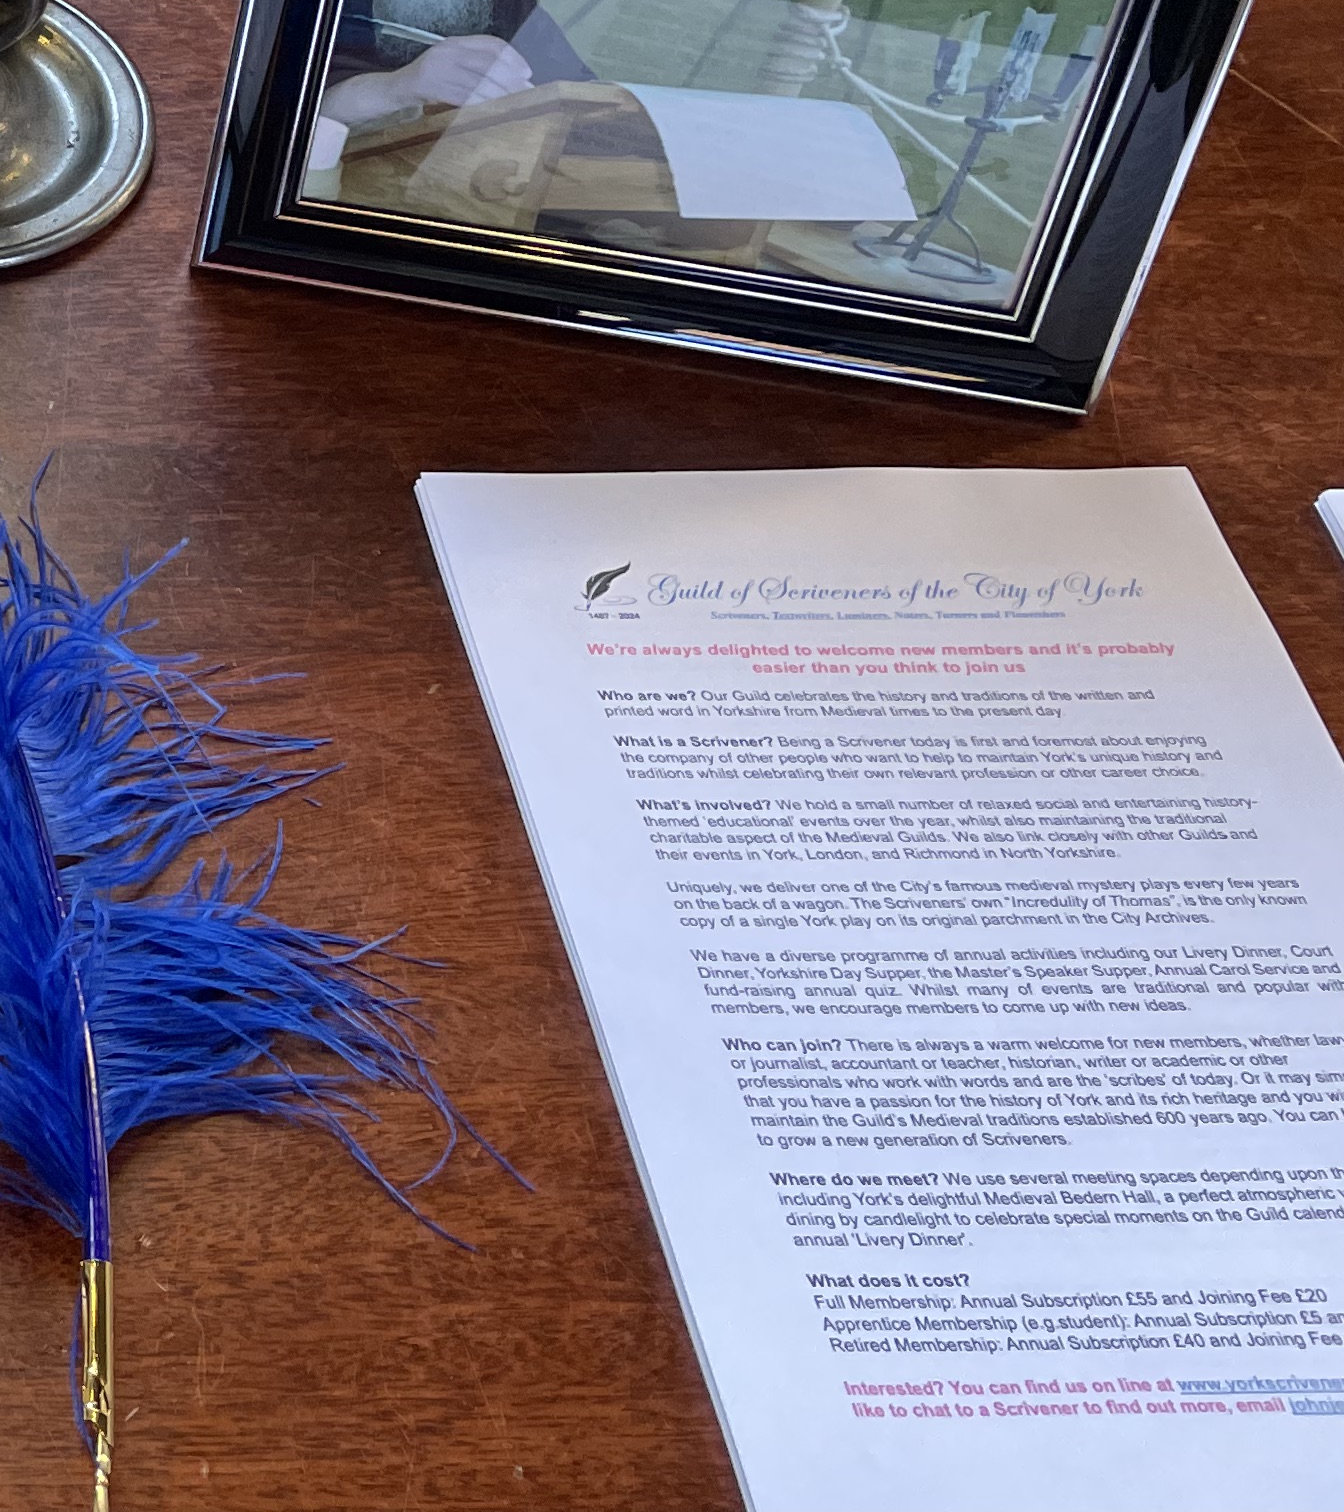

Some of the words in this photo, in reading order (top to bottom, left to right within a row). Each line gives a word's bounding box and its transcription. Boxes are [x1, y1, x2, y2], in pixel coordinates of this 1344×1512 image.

[647, 573, 724, 606] Guild
[730, 579, 755, 606] of
[758, 576, 892, 604] Scriveners
[898, 580, 925, 609] of
[925, 580, 958, 600] the
[964, 572, 1028, 609] City
[1038, 580, 1060, 608] of
[1064, 573, 1144, 608] York
[813, 1294, 846, 1310] Full
[847, 1294, 957, 1313] Membership:
[960, 1293, 1018, 1309] Annual
[1020, 1292, 1124, 1311] Subscription
[1125, 1291, 1158, 1307] £55
[1161, 1290, 1194, 1306] and
[1198, 1289, 1256, 1307] Joining
[1258, 1288, 1292, 1304] Fee
[1294, 1288, 1328, 1303] £20
